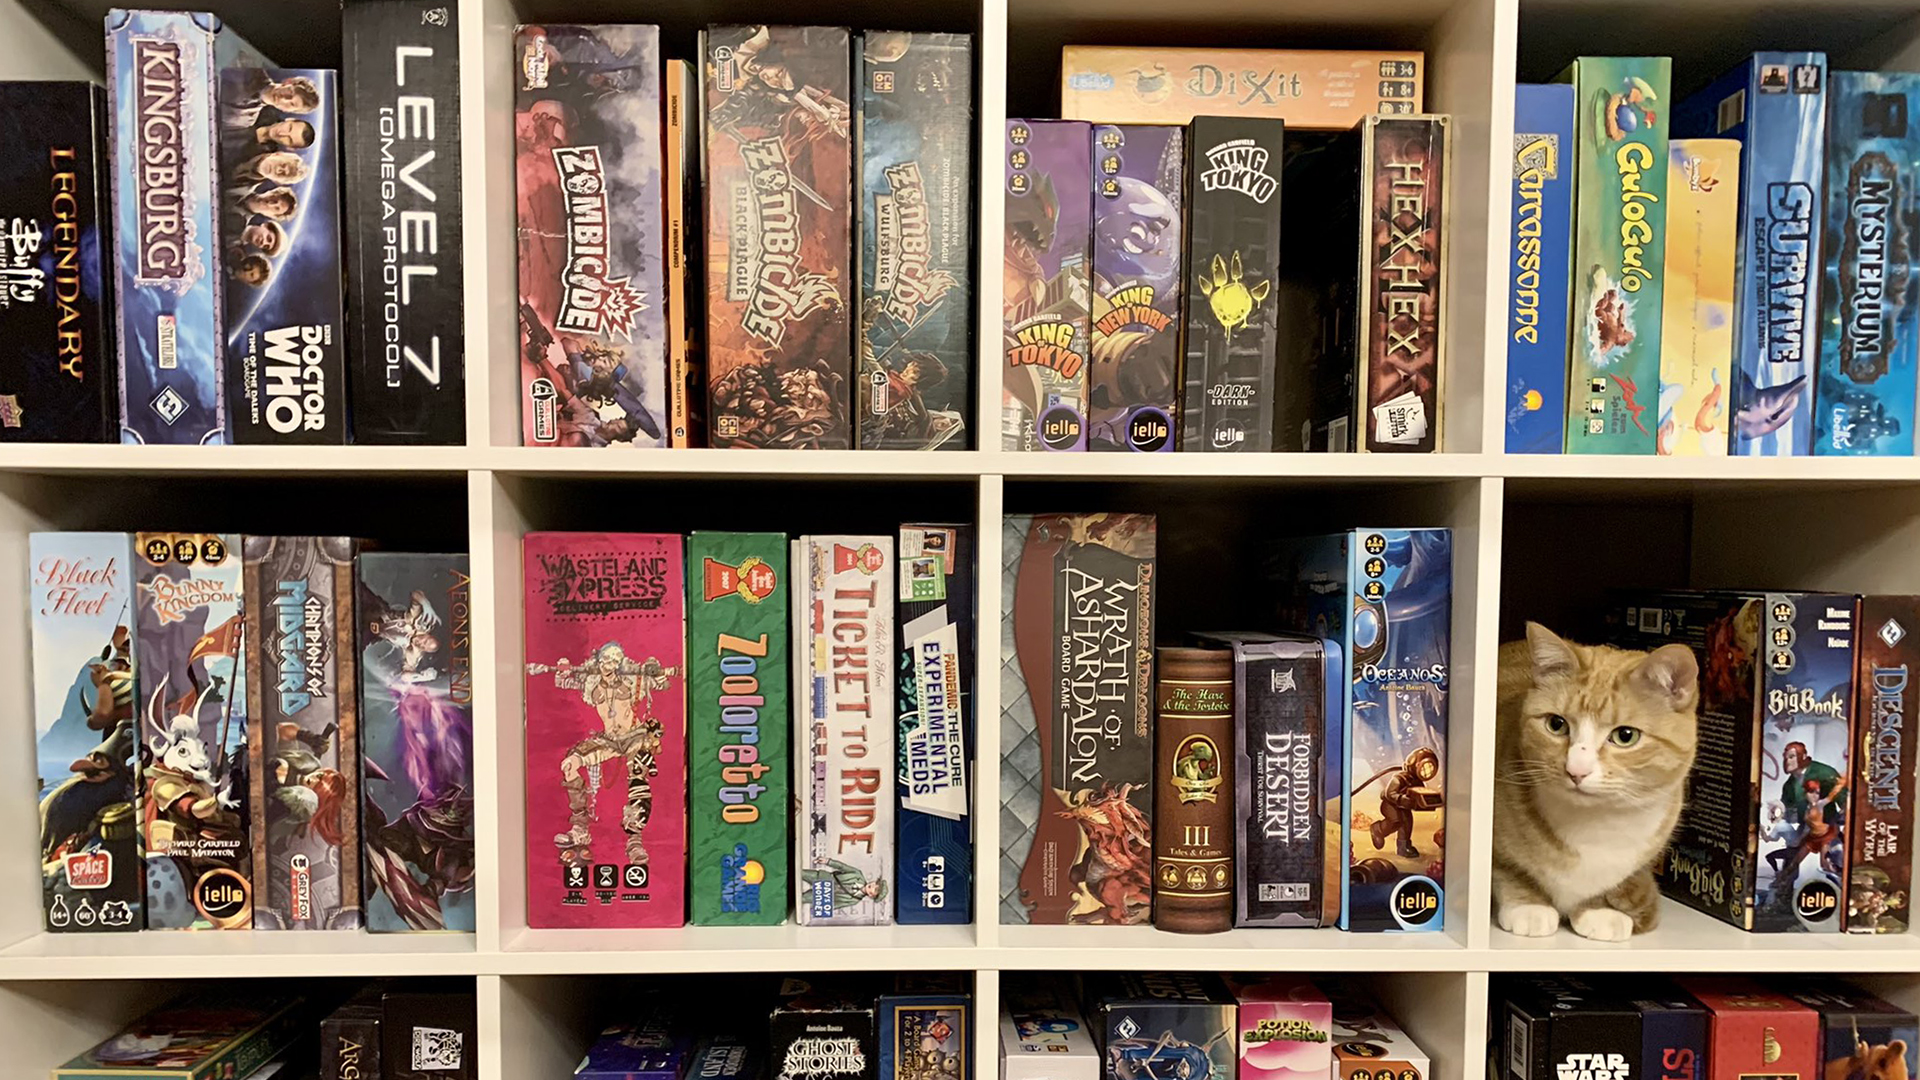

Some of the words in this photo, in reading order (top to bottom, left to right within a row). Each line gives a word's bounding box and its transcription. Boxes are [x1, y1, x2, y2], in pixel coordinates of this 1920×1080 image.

[142, 48, 180, 271] KINGSBURG
[396, 46, 438, 304] LEVEL
[1209, 147, 1269, 174] KING
[1201, 168, 1277, 204] TOKYO
[735, 186, 748, 234] BLACK
[553, 147, 612, 334] ZOMBICIDE
[880, 203, 890, 284] WULFSBURG
[1754, 217, 1767, 271] ESCAPE
[5, 217, 45, 303] Buffy
[50, 147, 83, 382] LEGENDARY
[735, 237, 748, 295] PLAGUE
[1767, 181, 1814, 362] SURVIVE
[1850, 178, 1893, 360] MYSTERIUM
[1110, 286, 1155, 308] KING
[1016, 322, 1075, 349] KING
[1095, 306, 1131, 338] NEW
[1132, 305, 1173, 333] YORK
[248, 331, 256, 354] TIME
[249, 355, 257, 366] OF
[403, 335, 440, 385] 7
[1007, 343, 1083, 379] TOKYO
[250, 367, 258, 388] THE
[264, 325, 302, 433] WHO
[301, 325, 325, 431] DOCTOR
[1212, 384, 1251, 399] DARK
[1045, 420, 1080, 435] iello
[1134, 422, 1168, 438] iello
[1215, 427, 1245, 442] iello
[1396, 407, 1408, 436] smirk
[35, 556, 118, 588] Black
[541, 556, 668, 579] WASTELAND
[721, 570, 730, 590] 2007
[41, 587, 109, 618] Fleet
[151, 592, 235, 625] KINGDOM
[1139, 563, 1153, 649] DUNGEONS
[276, 578, 311, 717] MIDGARD
[305, 596, 323, 678] CHAMPIONS
[833, 580, 878, 719] TICKET
[1100, 578, 1141, 703] WRATH
[1061, 635, 1071, 673] BOARD
[449, 656, 473, 705] END
[1060, 568, 1104, 784] ASHARDALON
[1362, 664, 1446, 684] OCEANOS
[1786, 684, 1797, 693] The
[1060, 677, 1071, 709] GAME
[1136, 663, 1151, 738] DRAGONS
[1163, 700, 1172, 710] &
[1174, 700, 1190, 711] the
[1172, 688, 1192, 700] The
[1195, 688, 1224, 700] Hare
[717, 633, 770, 824] Zooloretto
[923, 642, 950, 794] EXPERIMENTAL
[949, 711, 960, 744] THE
[1104, 715, 1123, 747] OF
[841, 724, 869, 759] TO
[1870, 663, 1908, 811] DESCENT
[910, 741, 931, 795] MEDS
[949, 745, 963, 787] CURE
[1256, 776, 1264, 790] FOR
[1263, 730, 1293, 847] DESERT
[1293, 732, 1311, 841] FORBIDDEN
[837, 767, 881, 855] RIDE
[1256, 791, 1264, 823] SURVIVAL
[1183, 826, 1210, 846] III
[1864, 818, 1878, 862] WYRM
[1877, 822, 1886, 833] OF
[1886, 824, 1899, 855] LAIR
[1170, 848, 1188, 856] Tales
[1200, 848, 1222, 856] Games
[1877, 838, 1886, 857] THE
[72, 859, 105, 877] SPACE
[205, 886, 243, 903] iello
[298, 872, 308, 897] GREY
[822, 882, 831, 904] DAYS
[1802, 892, 1836, 908] iello
[109, 911, 123, 919] 3-4
[299, 899, 308, 919] FOX
[823, 905, 831, 916] OF
[1400, 893, 1437, 909] iello
[904, 1016, 913, 1030] For
[1243, 1029, 1328, 1043] EXPLOSION
[1257, 1019, 1314, 1030] POTION
[792, 1039, 858, 1056] GHOST
[1556, 1054, 1629, 1070] STAR
[787, 1056, 864, 1072] STORIES
